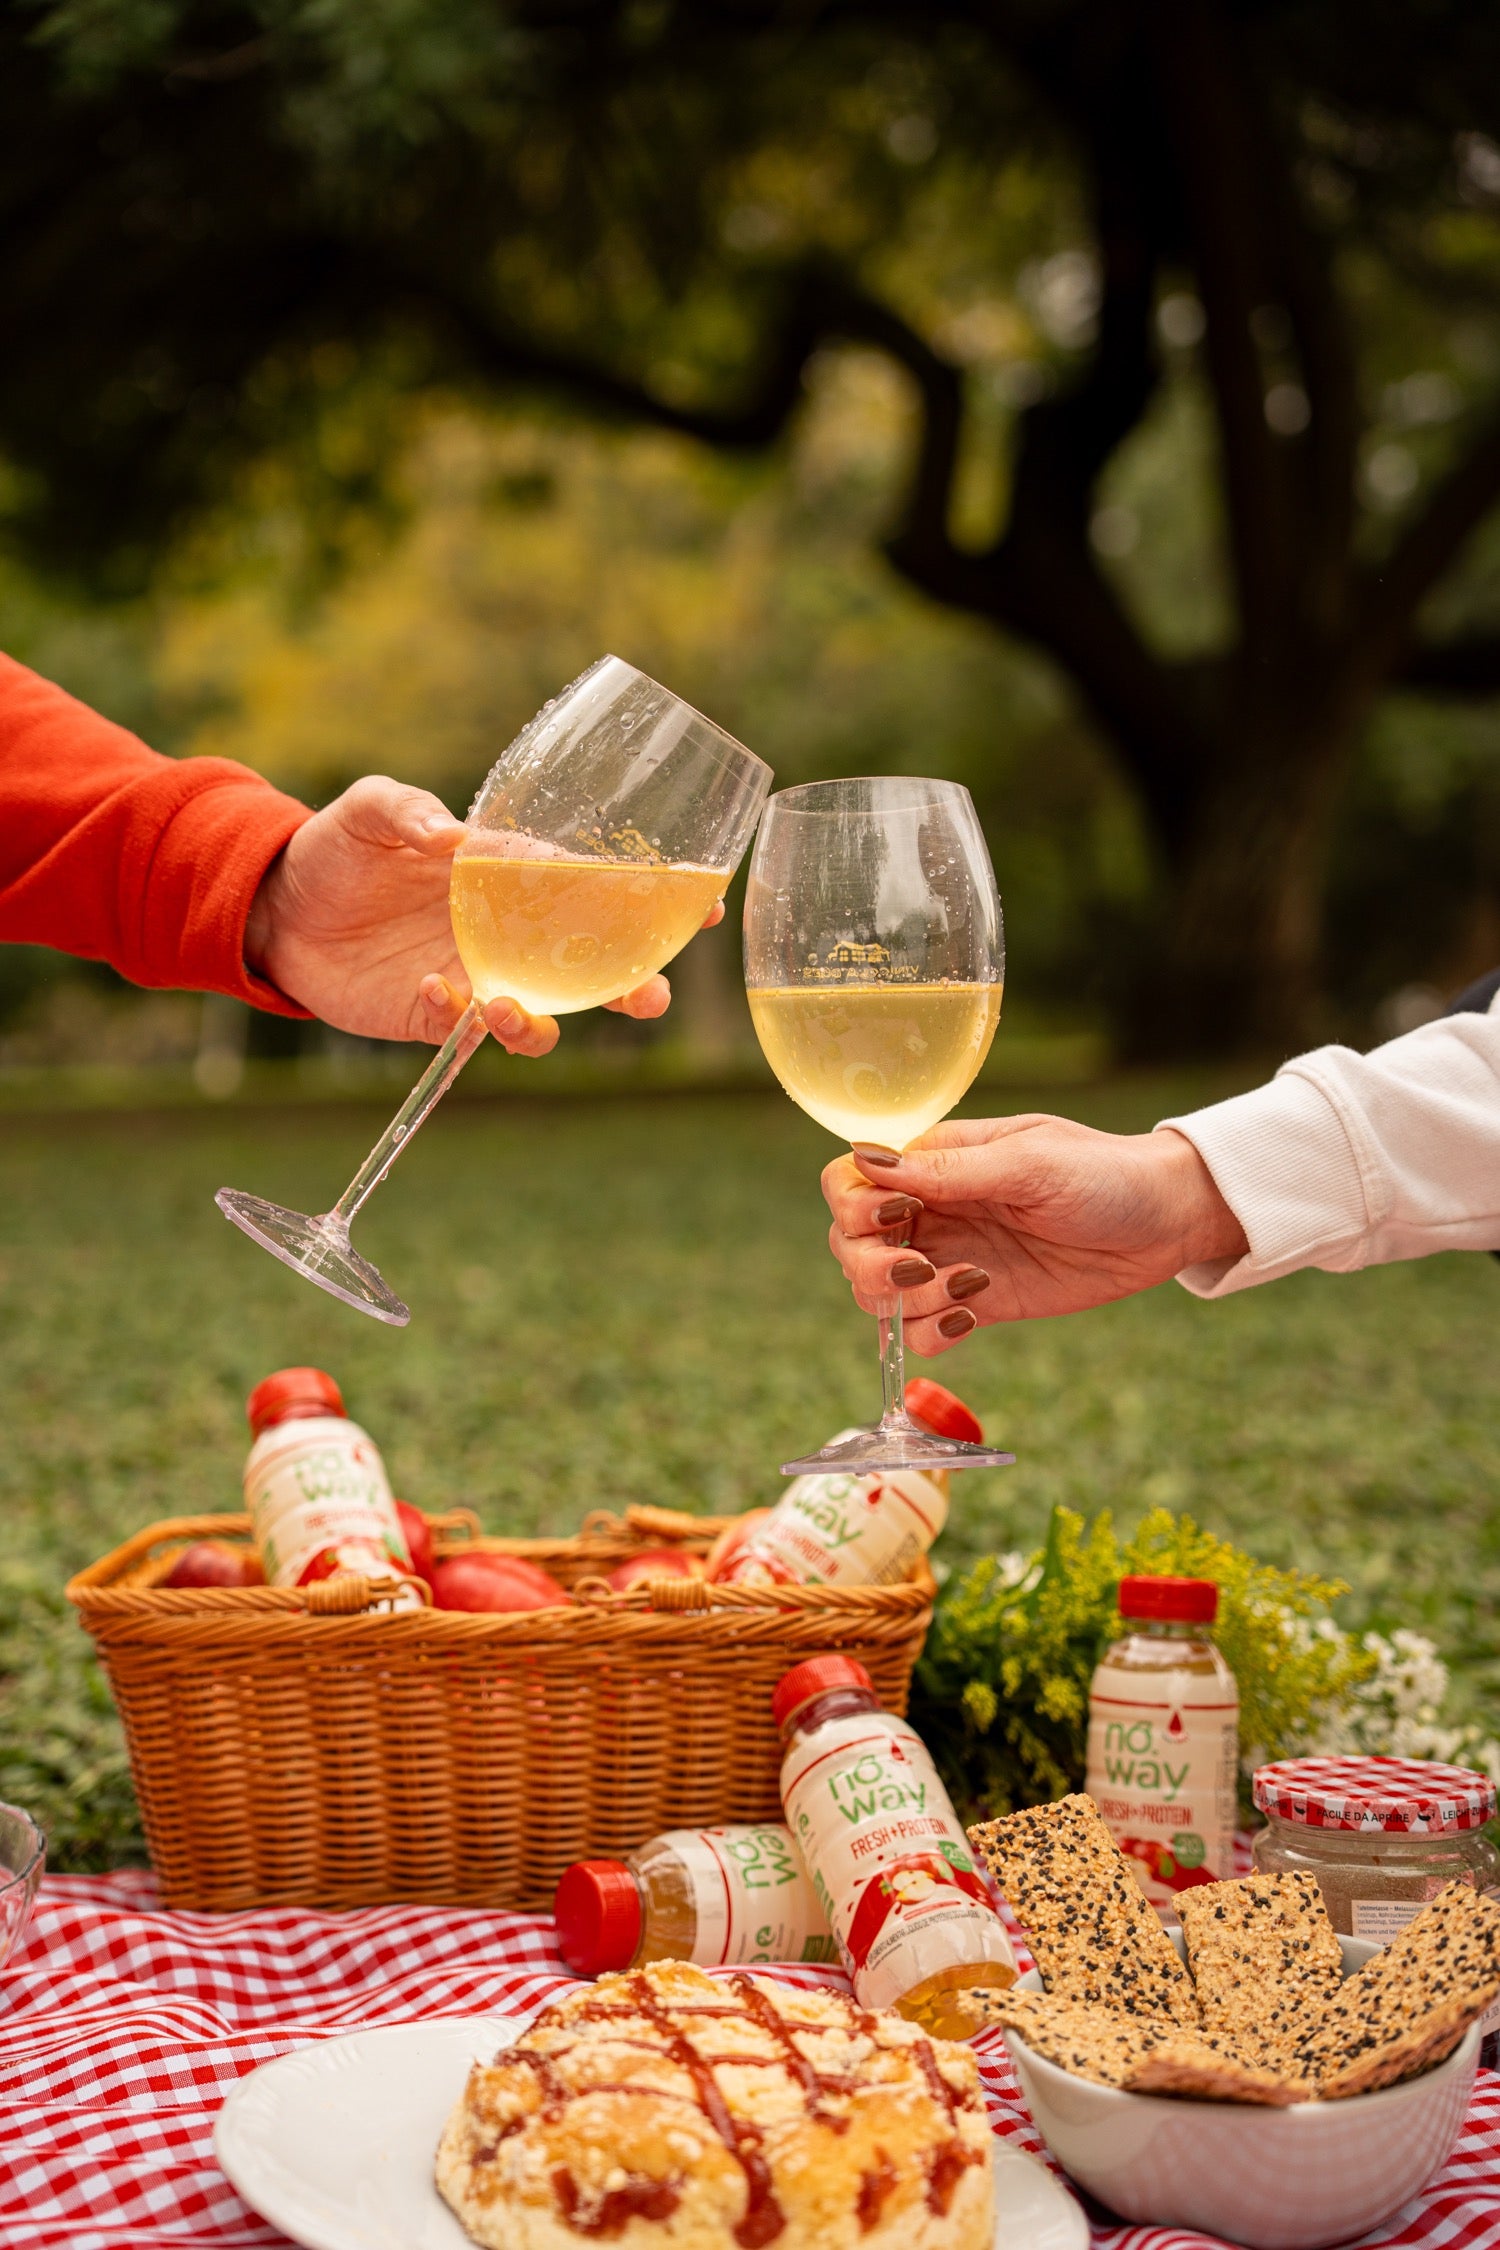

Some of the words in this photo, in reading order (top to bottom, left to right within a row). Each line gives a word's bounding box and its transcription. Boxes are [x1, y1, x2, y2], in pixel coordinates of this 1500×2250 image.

[1104, 1756, 1190, 1802] way
[838, 1782, 926, 1825] way
[1316, 1807, 1351, 1821] FACILE
[1354, 1811, 1368, 1822] DA
[1371, 1813, 1410, 1823] APRIRE
